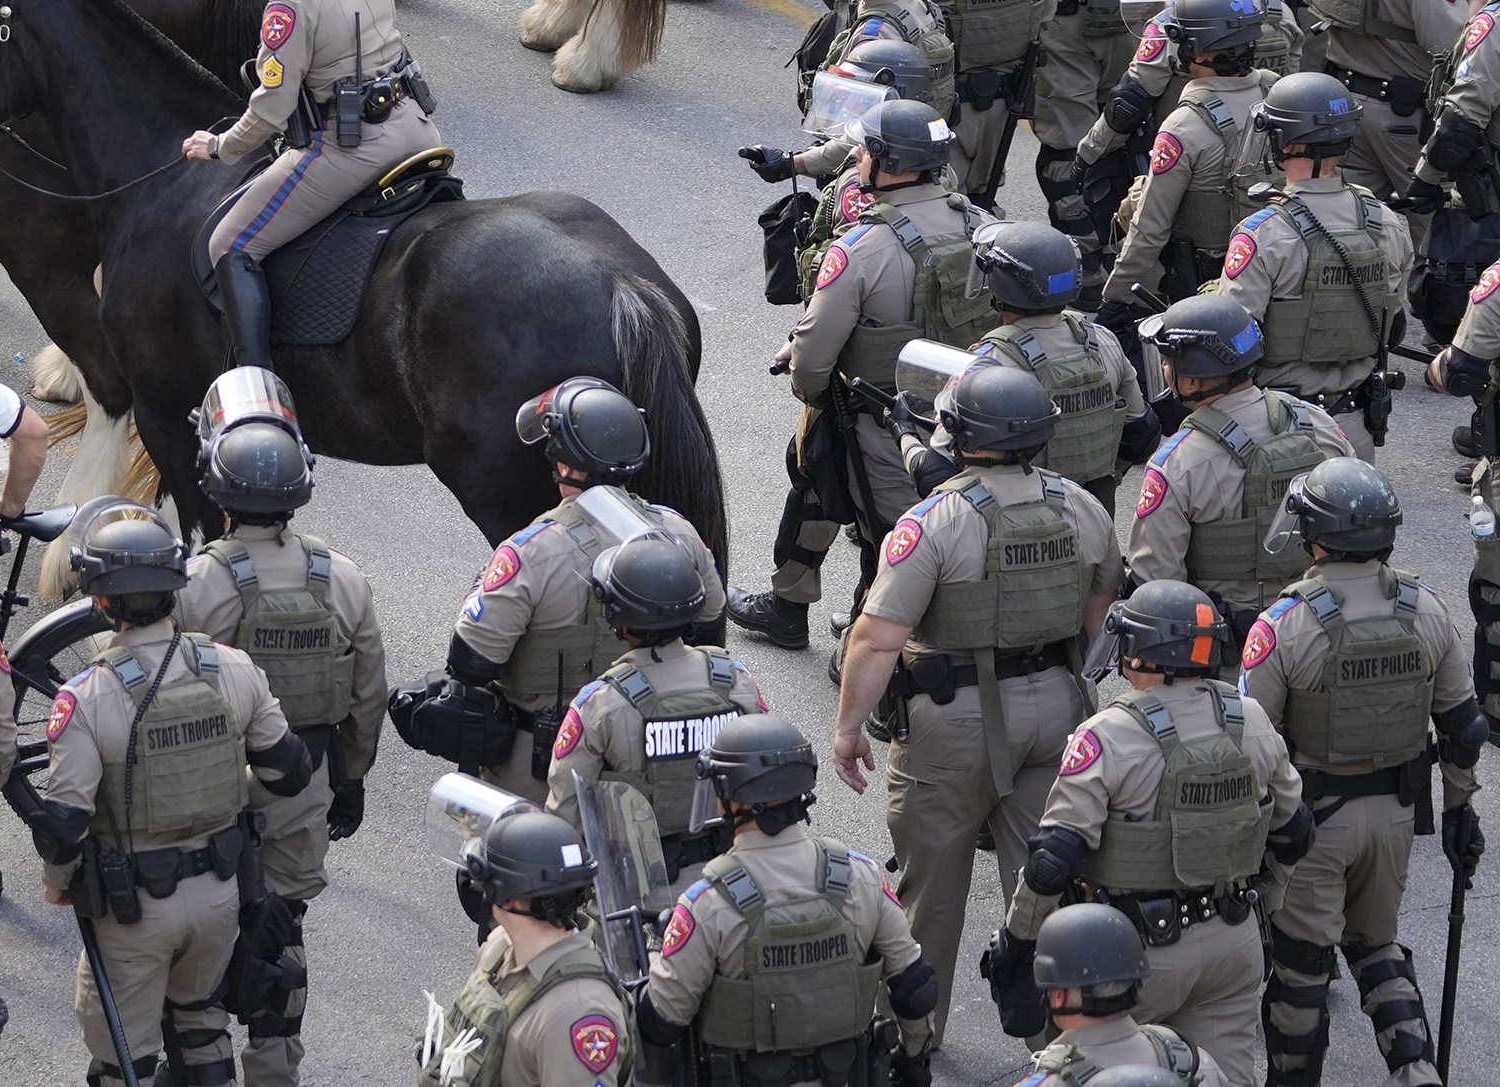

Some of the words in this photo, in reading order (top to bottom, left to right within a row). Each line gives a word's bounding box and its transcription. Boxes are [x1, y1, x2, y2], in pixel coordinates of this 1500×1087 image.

[1253, 54, 1286, 69] ATE
[1355, 262, 1385, 284] POLICE
[1052, 393, 1081, 414] STATE
[1081, 382, 1114, 410] TROOPER
[1004, 541, 1039, 566] STATE
[1040, 535, 1076, 562] POLICE
[254, 627, 285, 649] STATE
[287, 626, 331, 650] TROOPER
[1341, 657, 1378, 681] STATE
[1380, 650, 1421, 677] POLICE
[147, 724, 181, 750] STATE
[181, 714, 228, 744] TROOPER
[645, 720, 686, 758] STATE
[1180, 782, 1212, 805] STATE
[1213, 774, 1253, 804] TROOPER
[762, 944, 798, 969] STATE
[799, 933, 849, 965] TROOPER
